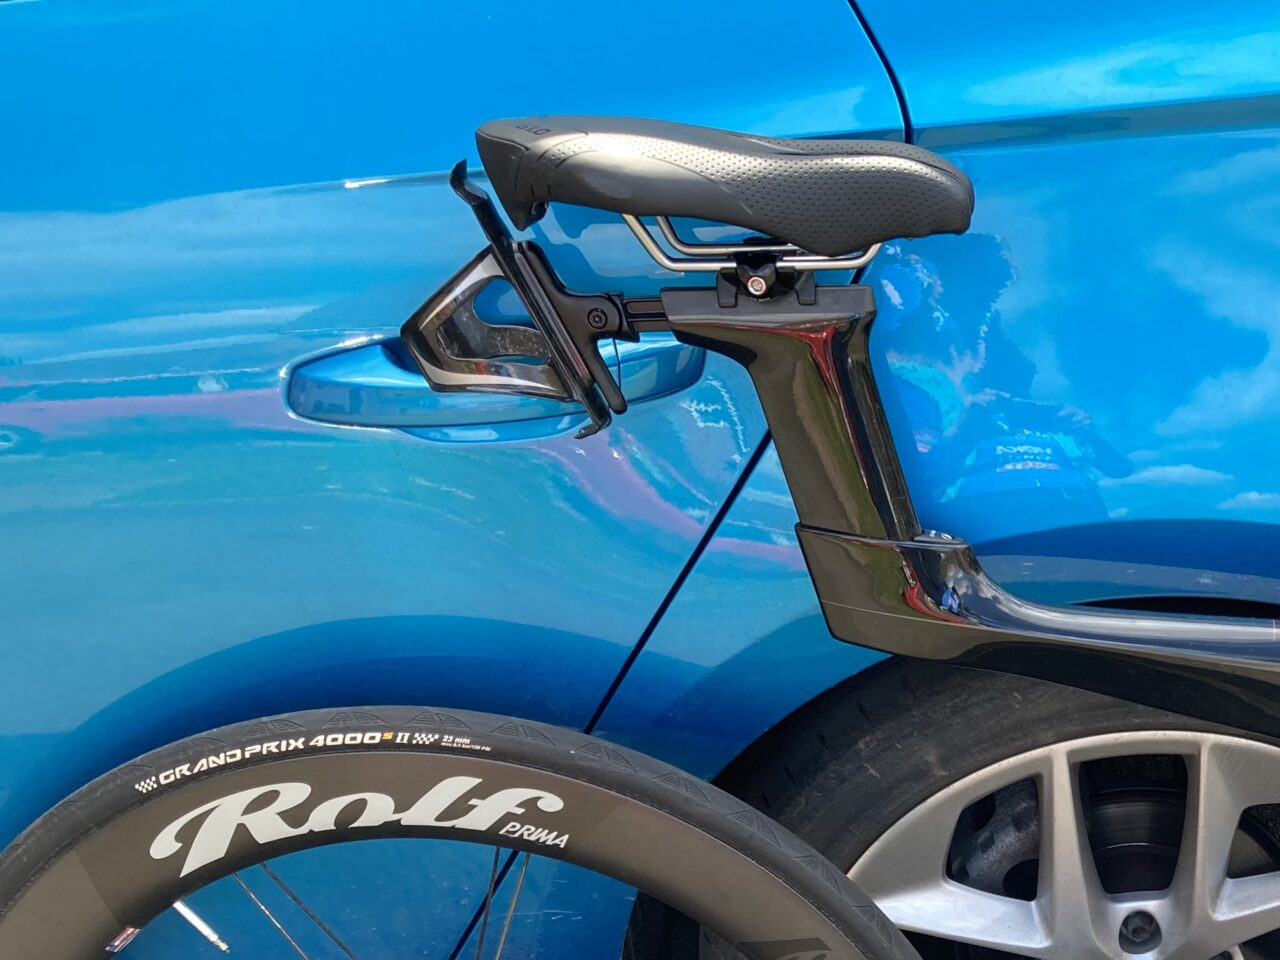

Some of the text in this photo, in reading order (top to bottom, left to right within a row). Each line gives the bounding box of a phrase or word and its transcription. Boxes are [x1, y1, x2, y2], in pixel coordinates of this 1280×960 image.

[158, 749, 242, 786] GRAND
[244, 737, 306, 759] PRIX
[149, 776, 570, 877] Rolf PRIMA
